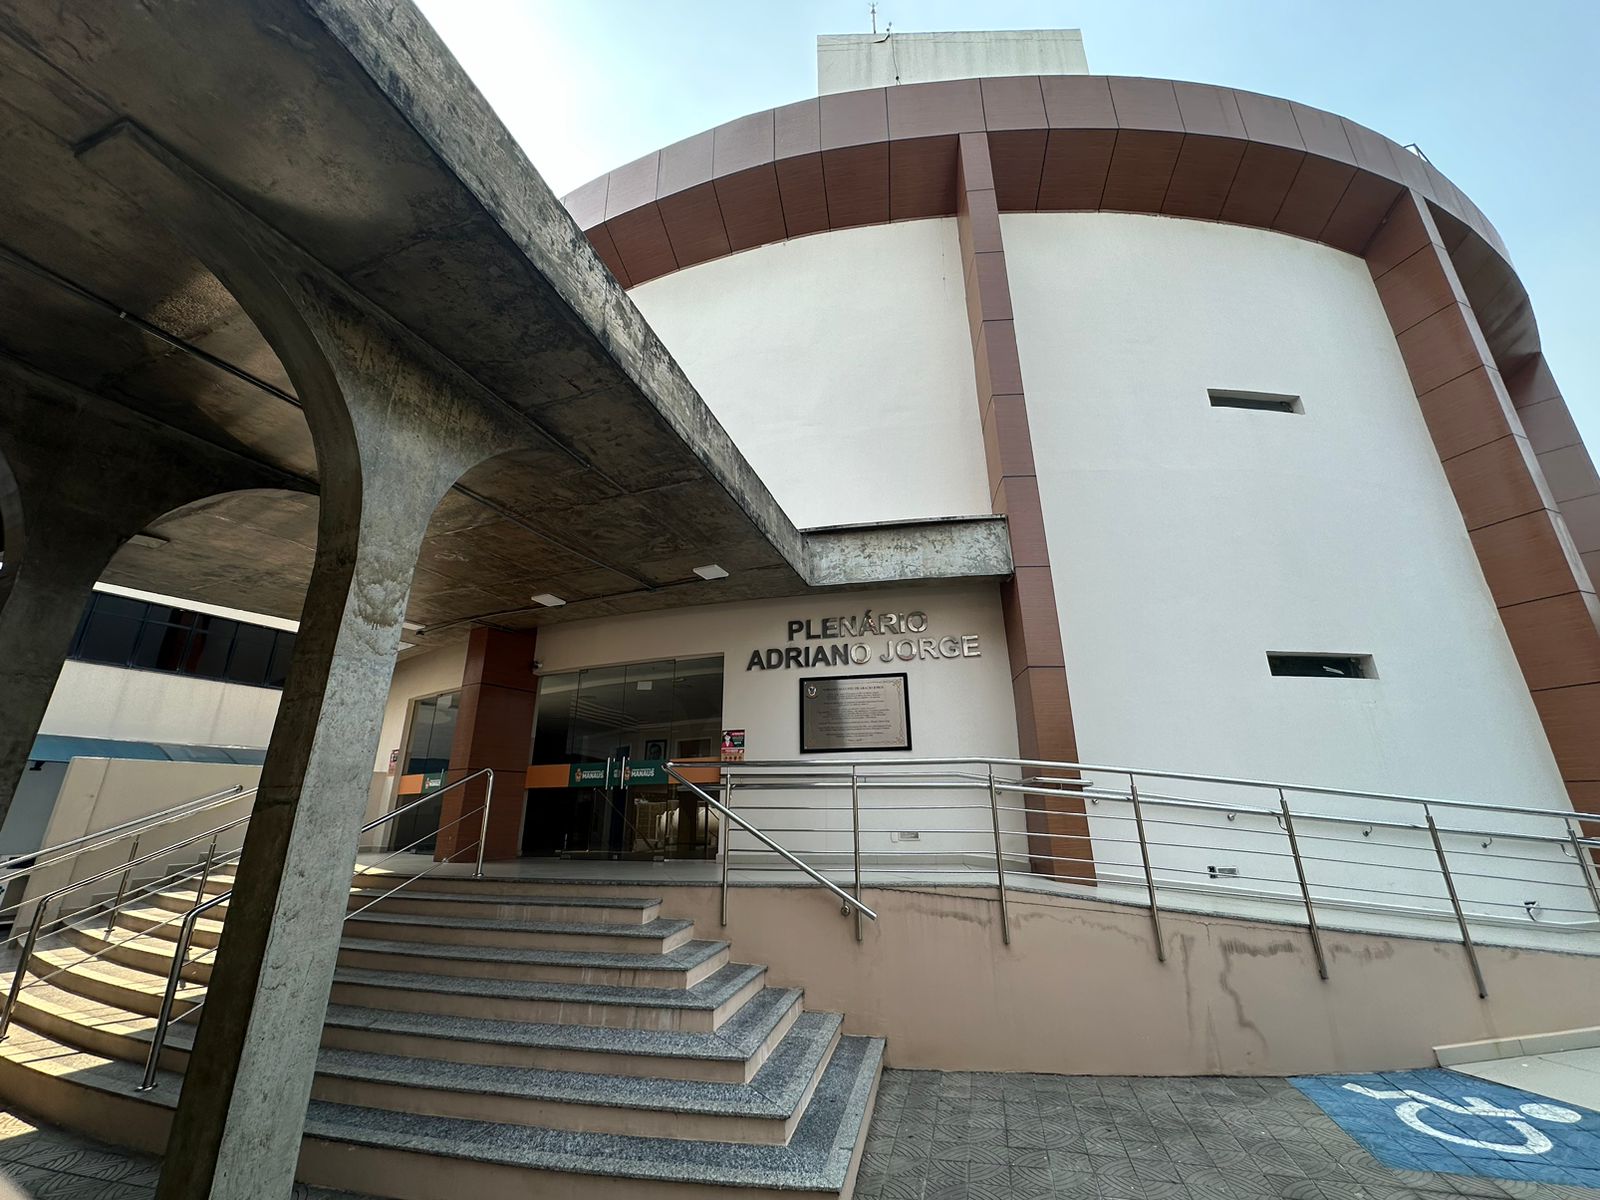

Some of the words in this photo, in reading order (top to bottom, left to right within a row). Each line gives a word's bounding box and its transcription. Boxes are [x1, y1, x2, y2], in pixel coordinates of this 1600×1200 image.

[787, 609, 928, 641] PLENÁRIO
[746, 643, 871, 671] ADRIANO
[880, 634, 981, 663] JORGE
